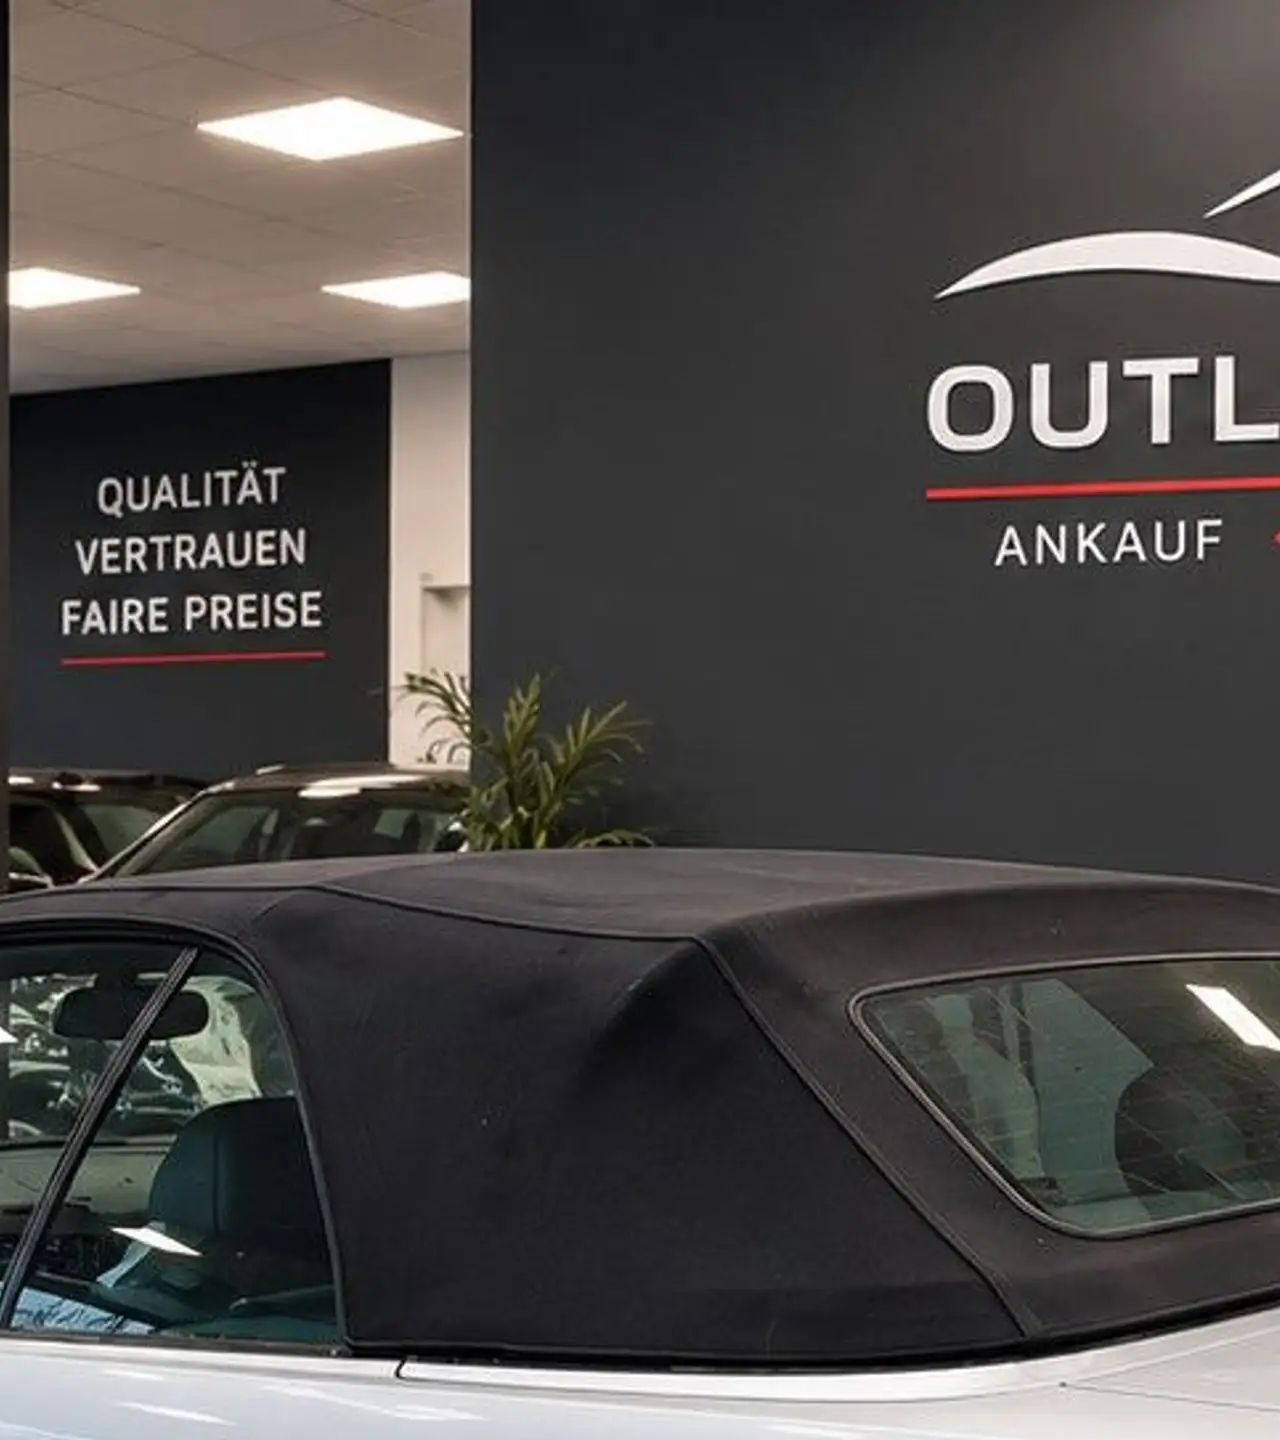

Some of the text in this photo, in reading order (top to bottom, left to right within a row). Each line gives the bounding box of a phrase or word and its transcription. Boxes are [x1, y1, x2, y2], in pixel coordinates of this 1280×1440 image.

[97, 461, 286, 518] QUALITÄT
[75, 528, 306, 575] VERTRAUEN
[994, 518, 1223, 567] ANKAUF
[62, 590, 322, 635] FAIRE PREISE
